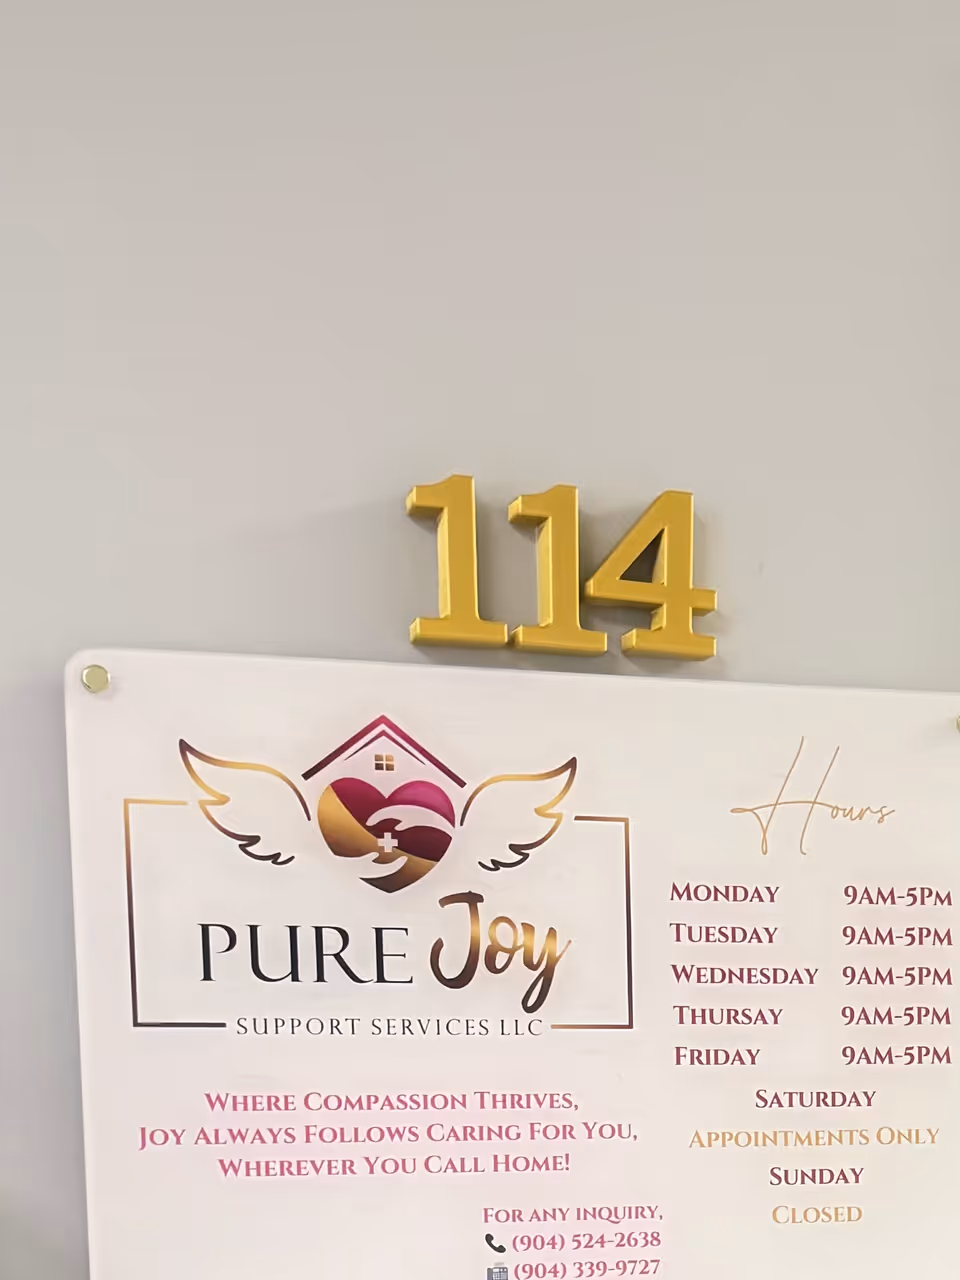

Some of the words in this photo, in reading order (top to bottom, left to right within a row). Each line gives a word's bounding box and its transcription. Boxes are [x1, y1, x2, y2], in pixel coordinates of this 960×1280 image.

[405, 474, 717, 661] 114
[730, 736, 895, 855] Hours
[670, 882, 779, 904] MONDAY
[669, 923, 778, 944] TUESDAY
[843, 926, 953, 946] 9AM-5PM
[197, 923, 413, 985] PURE
[429, 890, 572, 1014] Joy
[670, 964, 819, 984] WEDNESDAY
[843, 966, 952, 986] 9AM-5PM
[236, 1017, 360, 1036] SUPPORT
[372, 1018, 489, 1036] SERVICES
[501, 1019, 542, 1036] LLC
[673, 1006, 783, 1025] THURSAY
[841, 1006, 951, 1026] 9AM-5PM
[675, 1047, 760, 1065] FRIDAY
[842, 1046, 952, 1065] 9AM-5PM
[204, 1093, 296, 1111] WHERE
[304, 1092, 466, 1111] COMPASSION
[474, 1092, 578, 1111] THRIVES,
[756, 1089, 876, 1108] SATURDAY
[139, 1127, 186, 1151] JOY
[194, 1127, 296, 1145] ALWAYS
[305, 1125, 419, 1143] FOLLOWS
[427, 1123, 521, 1141] CARING
[529, 1122, 576, 1140] FOR
[582, 1122, 637, 1141] YOU,
[689, 1129, 869, 1148] APPOINTMENTS
[876, 1127, 939, 1145] ONLY
[217, 1159, 357, 1177] WHEREVER
[362, 1157, 416, 1174] YOU
[424, 1155, 485, 1173] CALL
[493, 1153, 569, 1172] HOME!
[769, 1167, 864, 1185] SUNDAY
[483, 1208, 524, 1223] FOR
[529, 1208, 570, 1222] ANY
[577, 1206, 663, 1224] INQUIRY,
[772, 1206, 862, 1223] CLOSED
[512, 1234, 565, 1252] (904)
[572, 1231, 661, 1250] 524-2638
[514, 1262, 566, 1280] (904)
[573, 1259, 660, 1278] 339-9727
